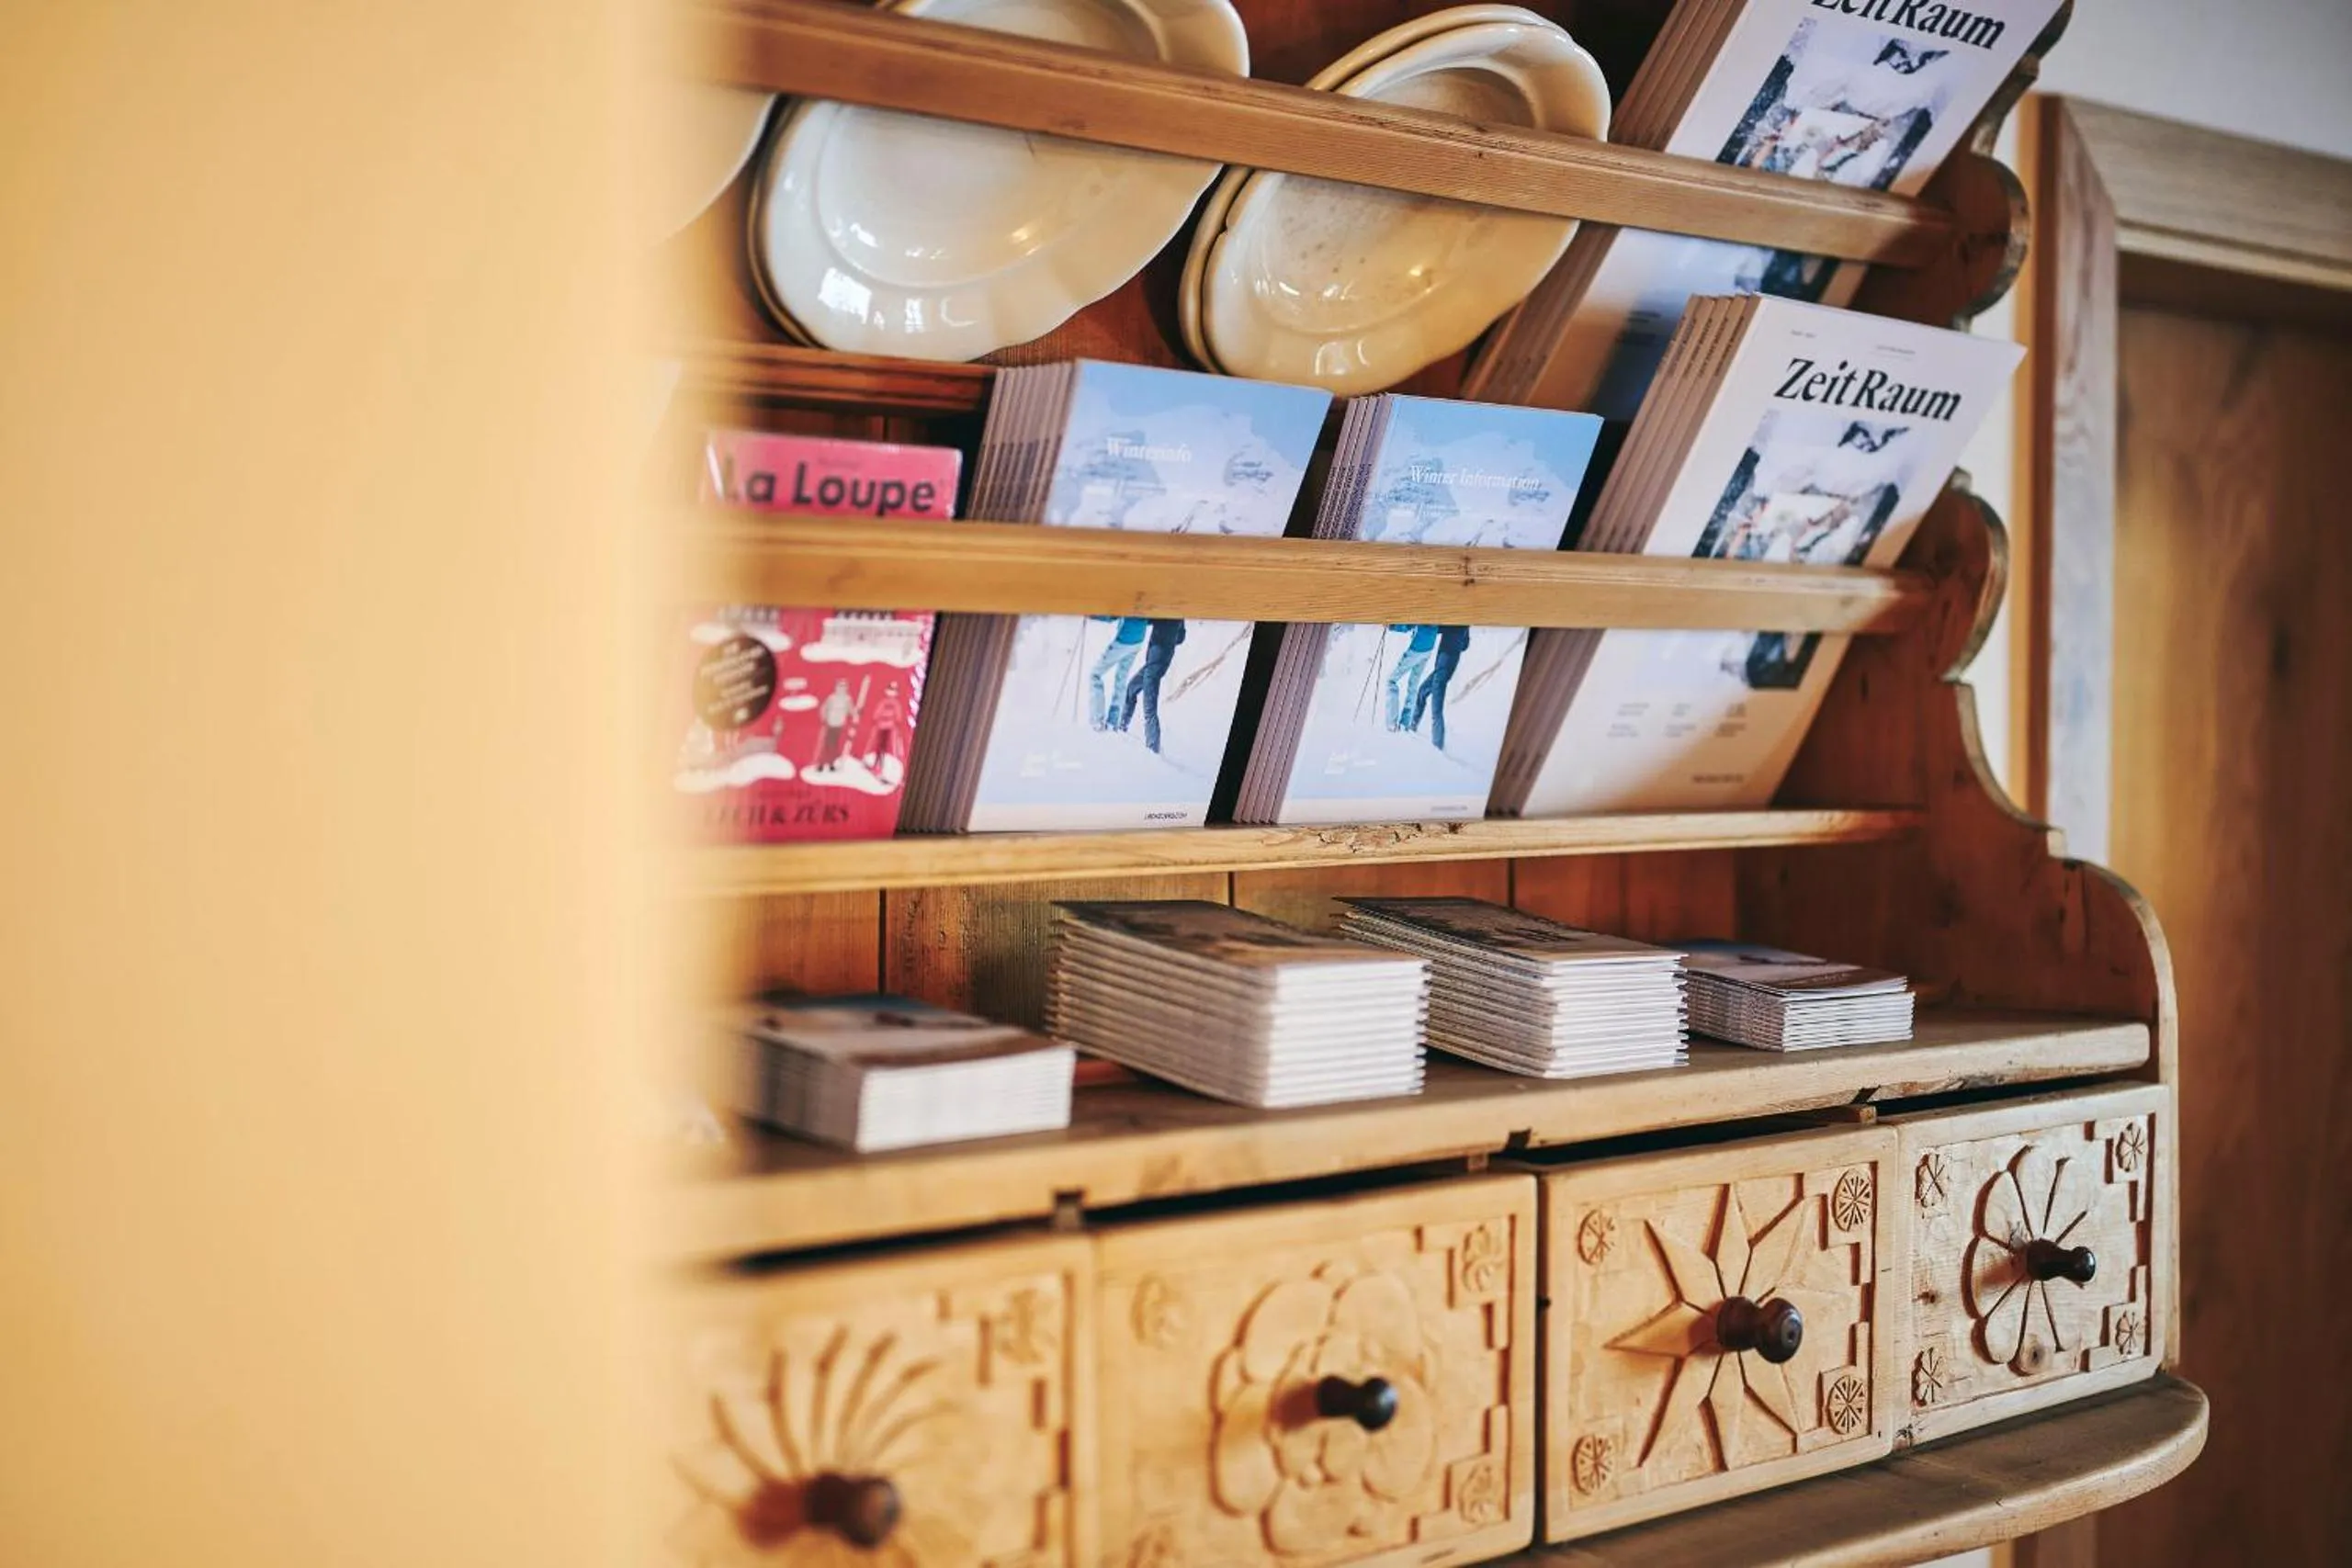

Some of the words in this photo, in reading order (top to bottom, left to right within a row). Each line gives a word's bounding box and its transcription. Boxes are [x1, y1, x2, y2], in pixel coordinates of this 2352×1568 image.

[1774, 357, 1962, 422] ZeitRaum
[791, 462, 935, 516] Loupe
[1410, 465, 1458, 484] Winter
[1460, 468, 1540, 491] Information
